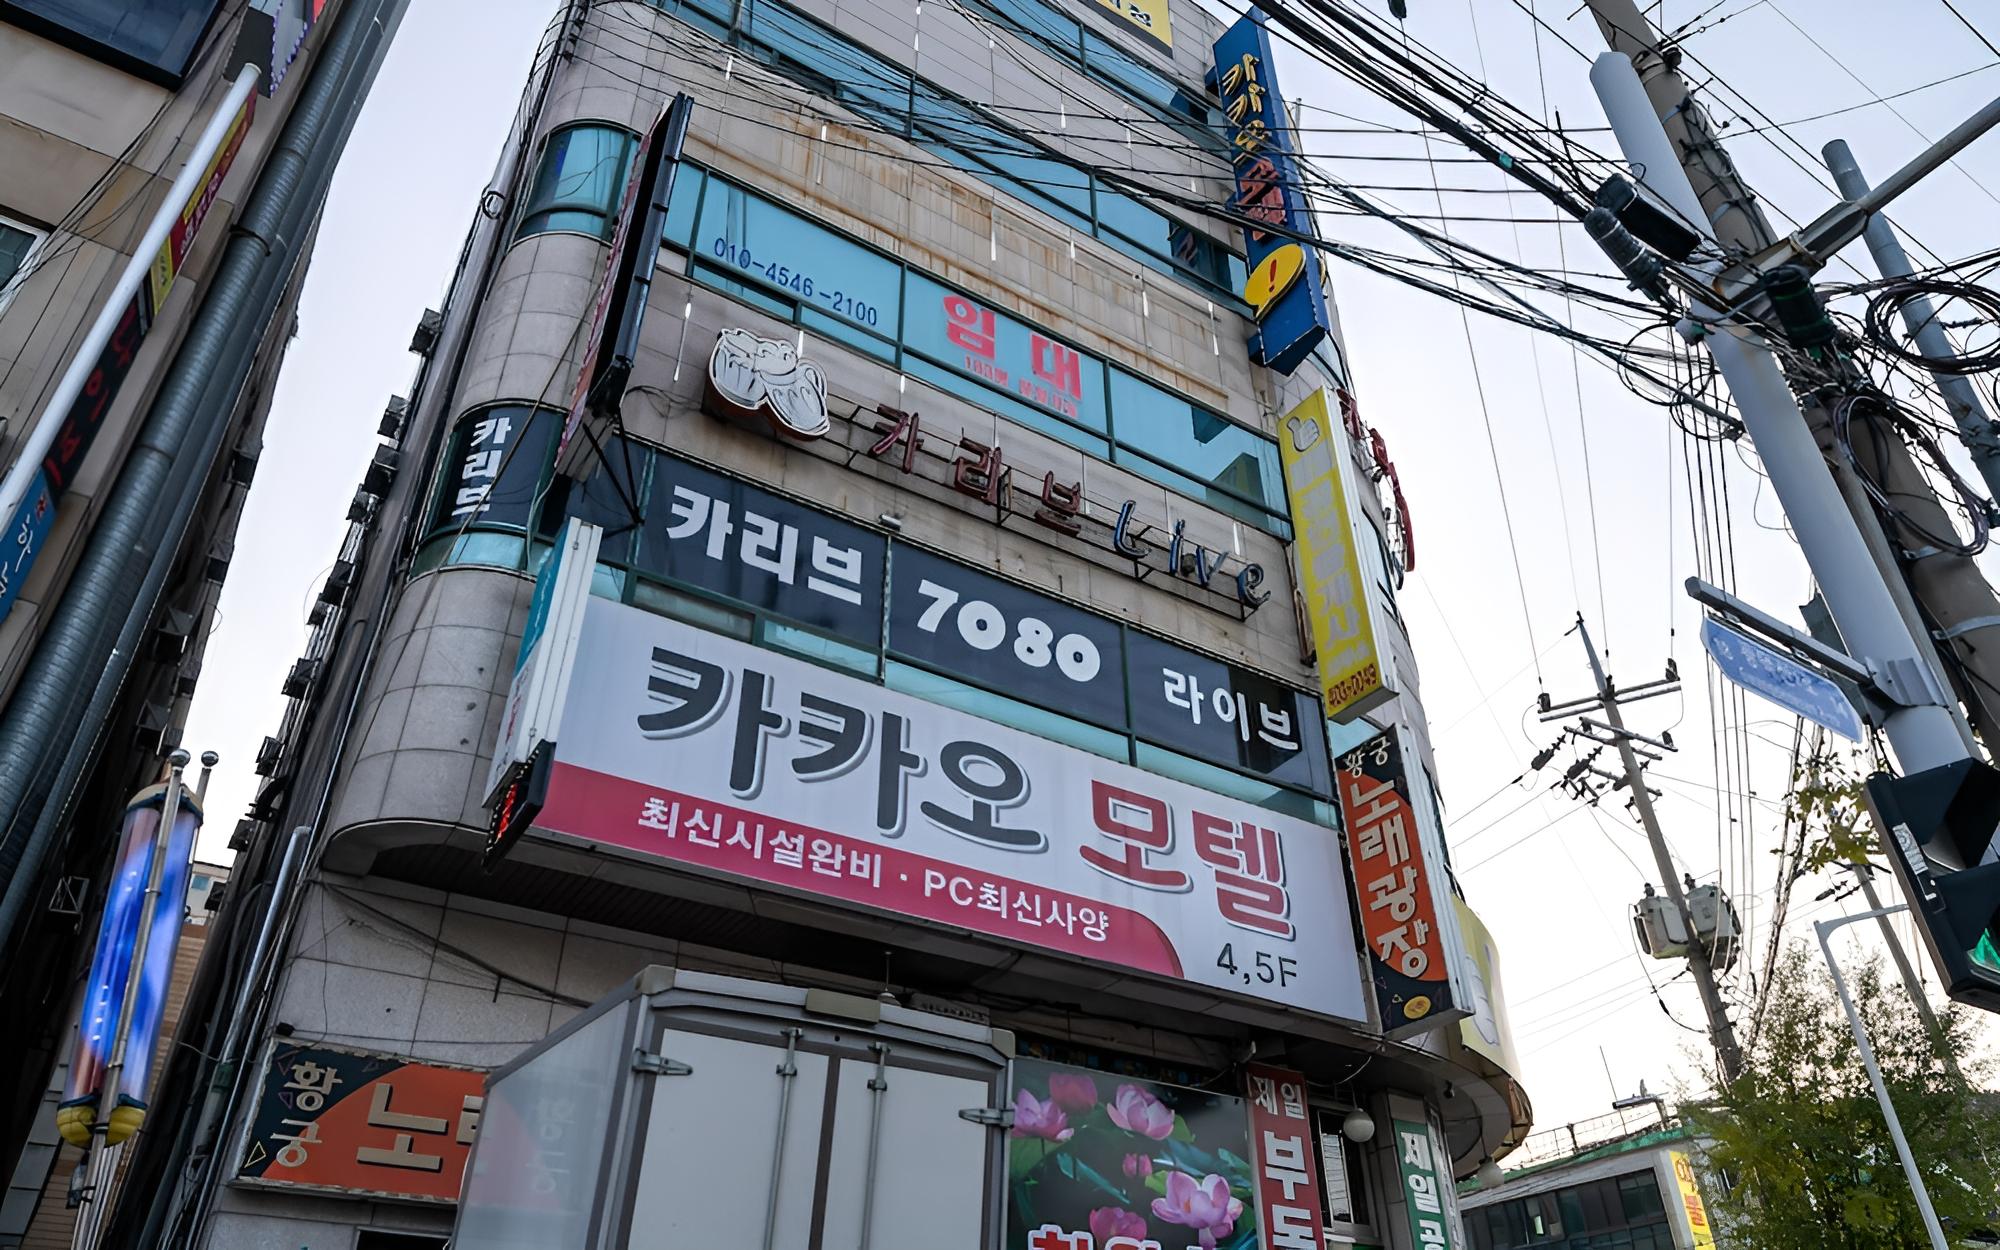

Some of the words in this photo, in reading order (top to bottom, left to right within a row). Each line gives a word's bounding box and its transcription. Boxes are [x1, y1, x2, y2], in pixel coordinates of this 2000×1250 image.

[714, 237, 878, 327] 010-4546-2100
[451, 417, 512, 517] 카리브
[868, 403, 1082, 538] 카리브
[666, 485, 862, 606] 카리브
[916, 579, 1102, 683] 7080
[1162, 667, 1299, 751] 라이브
[637, 646, 1049, 854] 카카오
[1079, 778, 1297, 942] 모텔
[637, 796, 882, 888] 최신시설완비
[924, 867, 1110, 942] PC최신사양
[1350, 779, 1430, 978] 노래광장
[1216, 942, 1299, 988] 4,5F
[269, 1061, 343, 1168] 황궁
[1253, 1076, 1305, 1119] 제일
